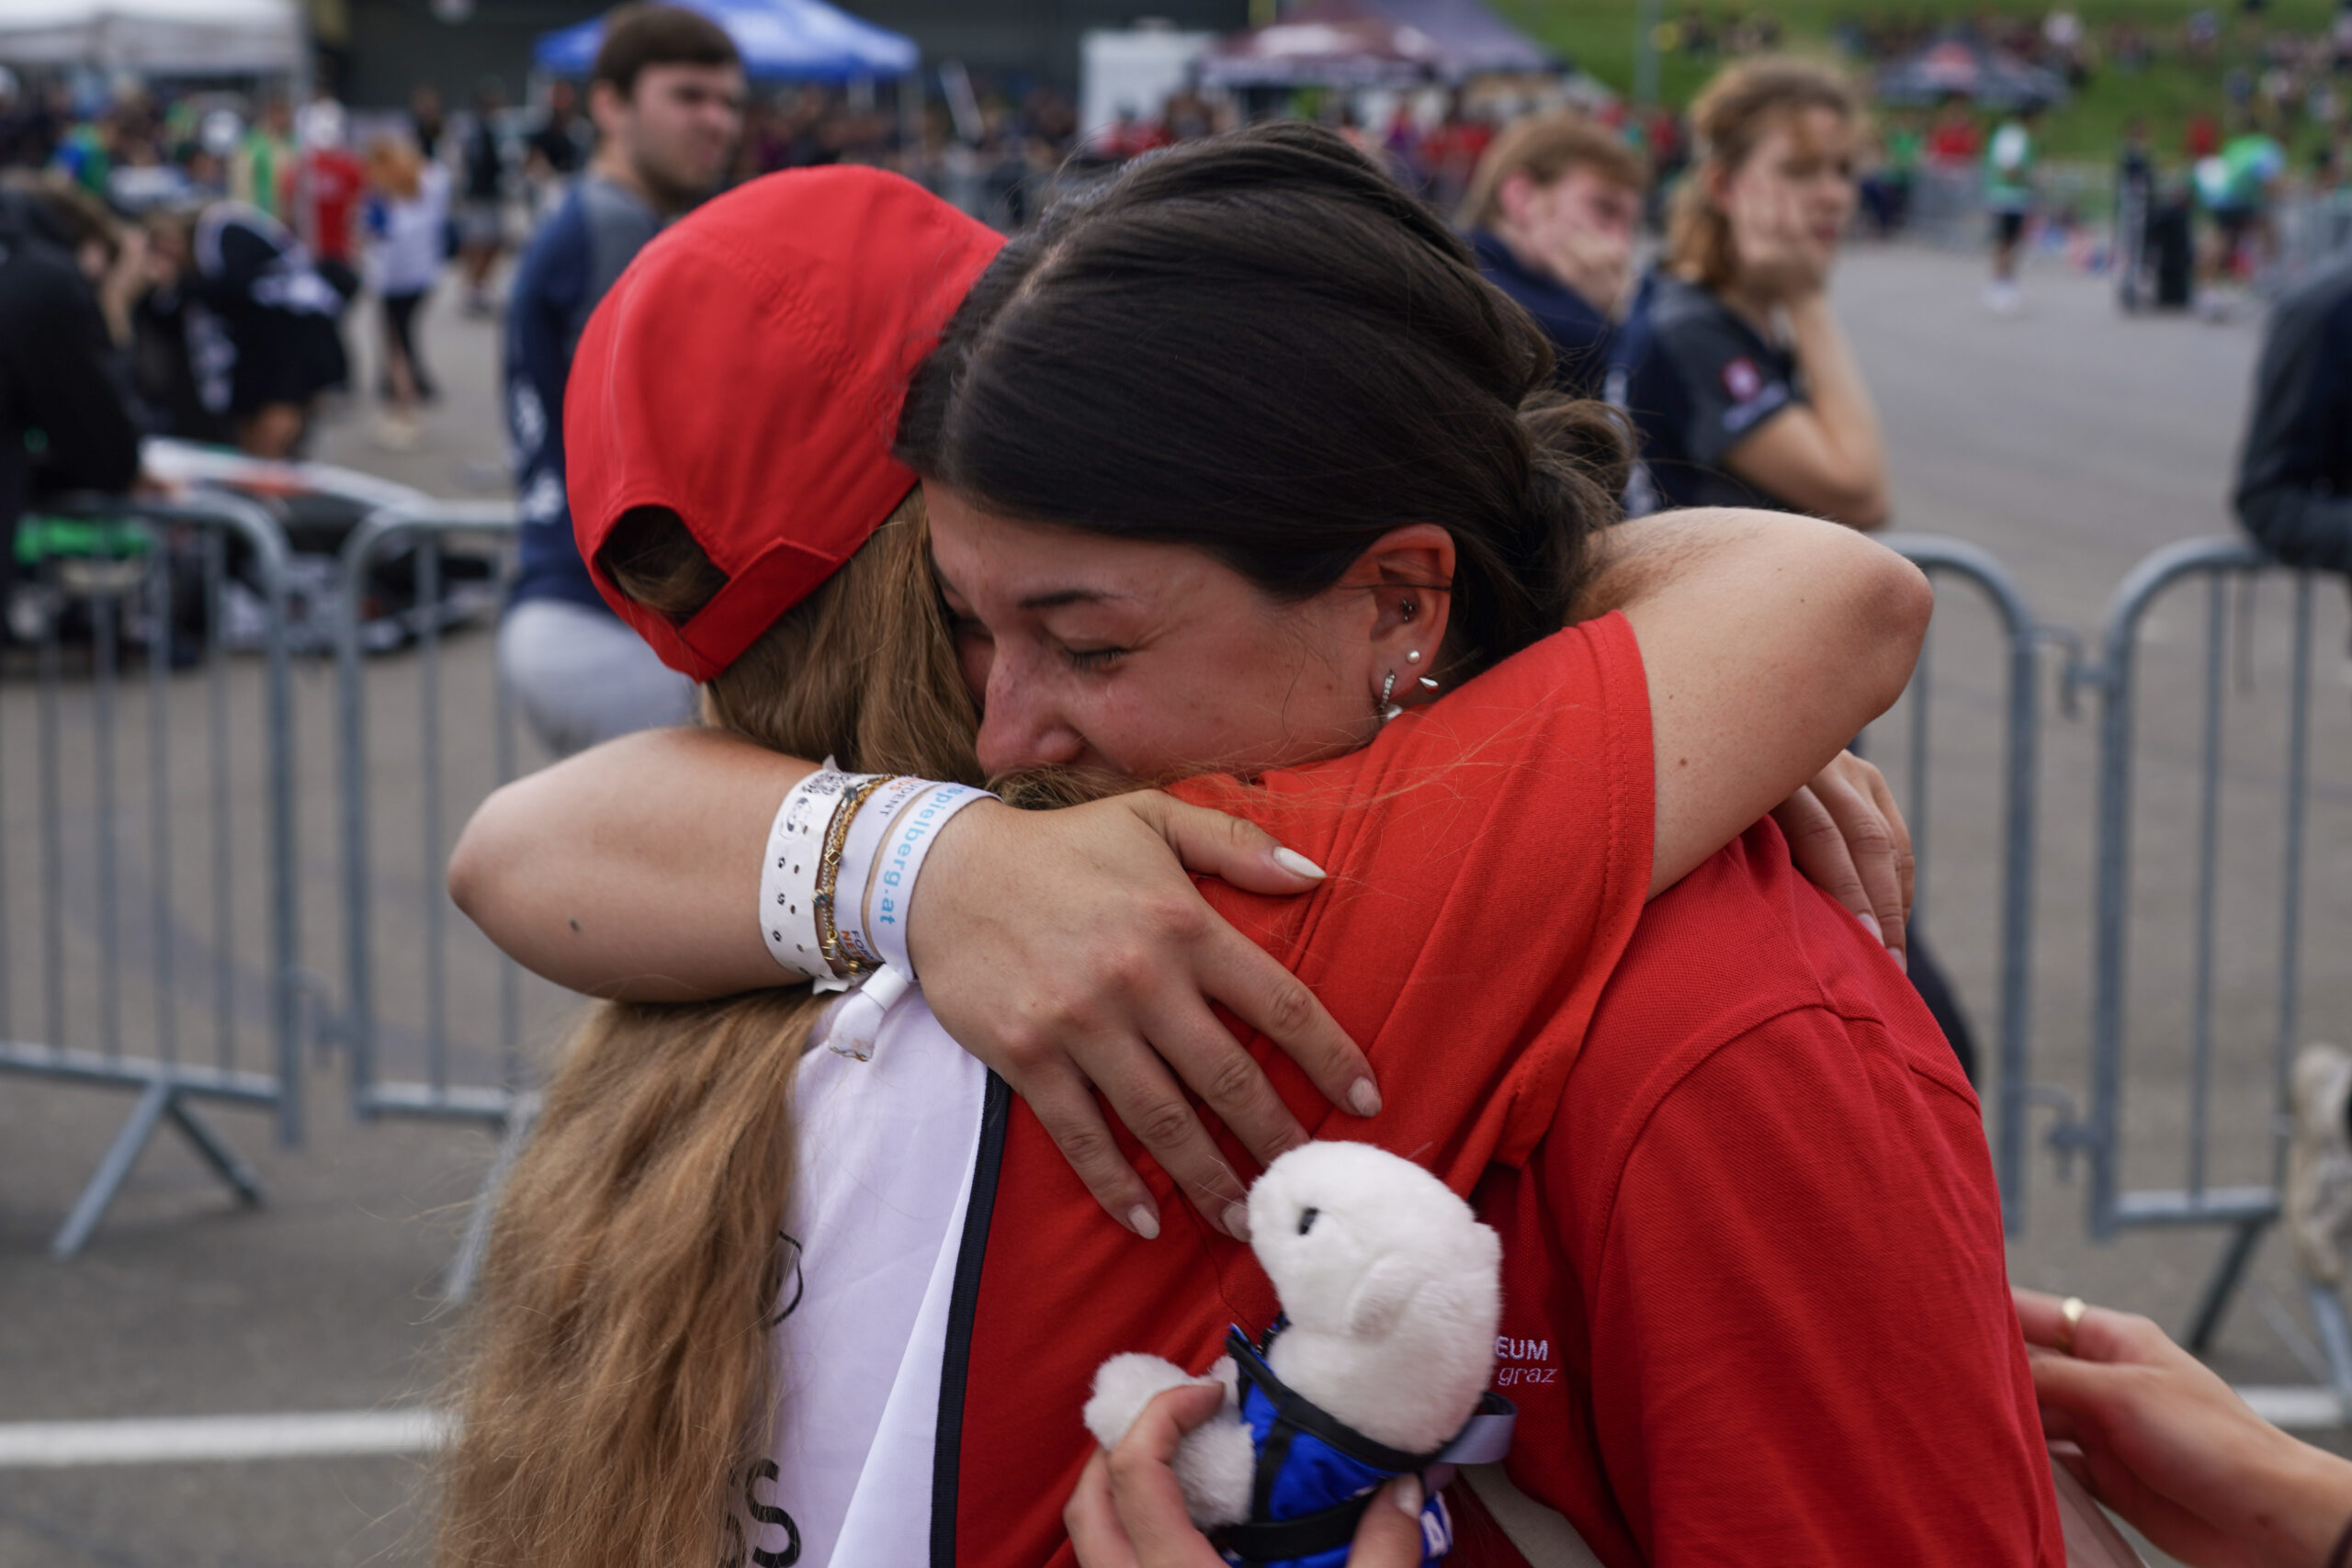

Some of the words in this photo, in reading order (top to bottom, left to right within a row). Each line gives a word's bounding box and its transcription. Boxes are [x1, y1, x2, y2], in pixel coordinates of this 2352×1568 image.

[879, 785, 965, 925] spielberg.at
[1495, 1336, 1549, 1361] EUM
[1498, 1367, 1557, 1386] graz
